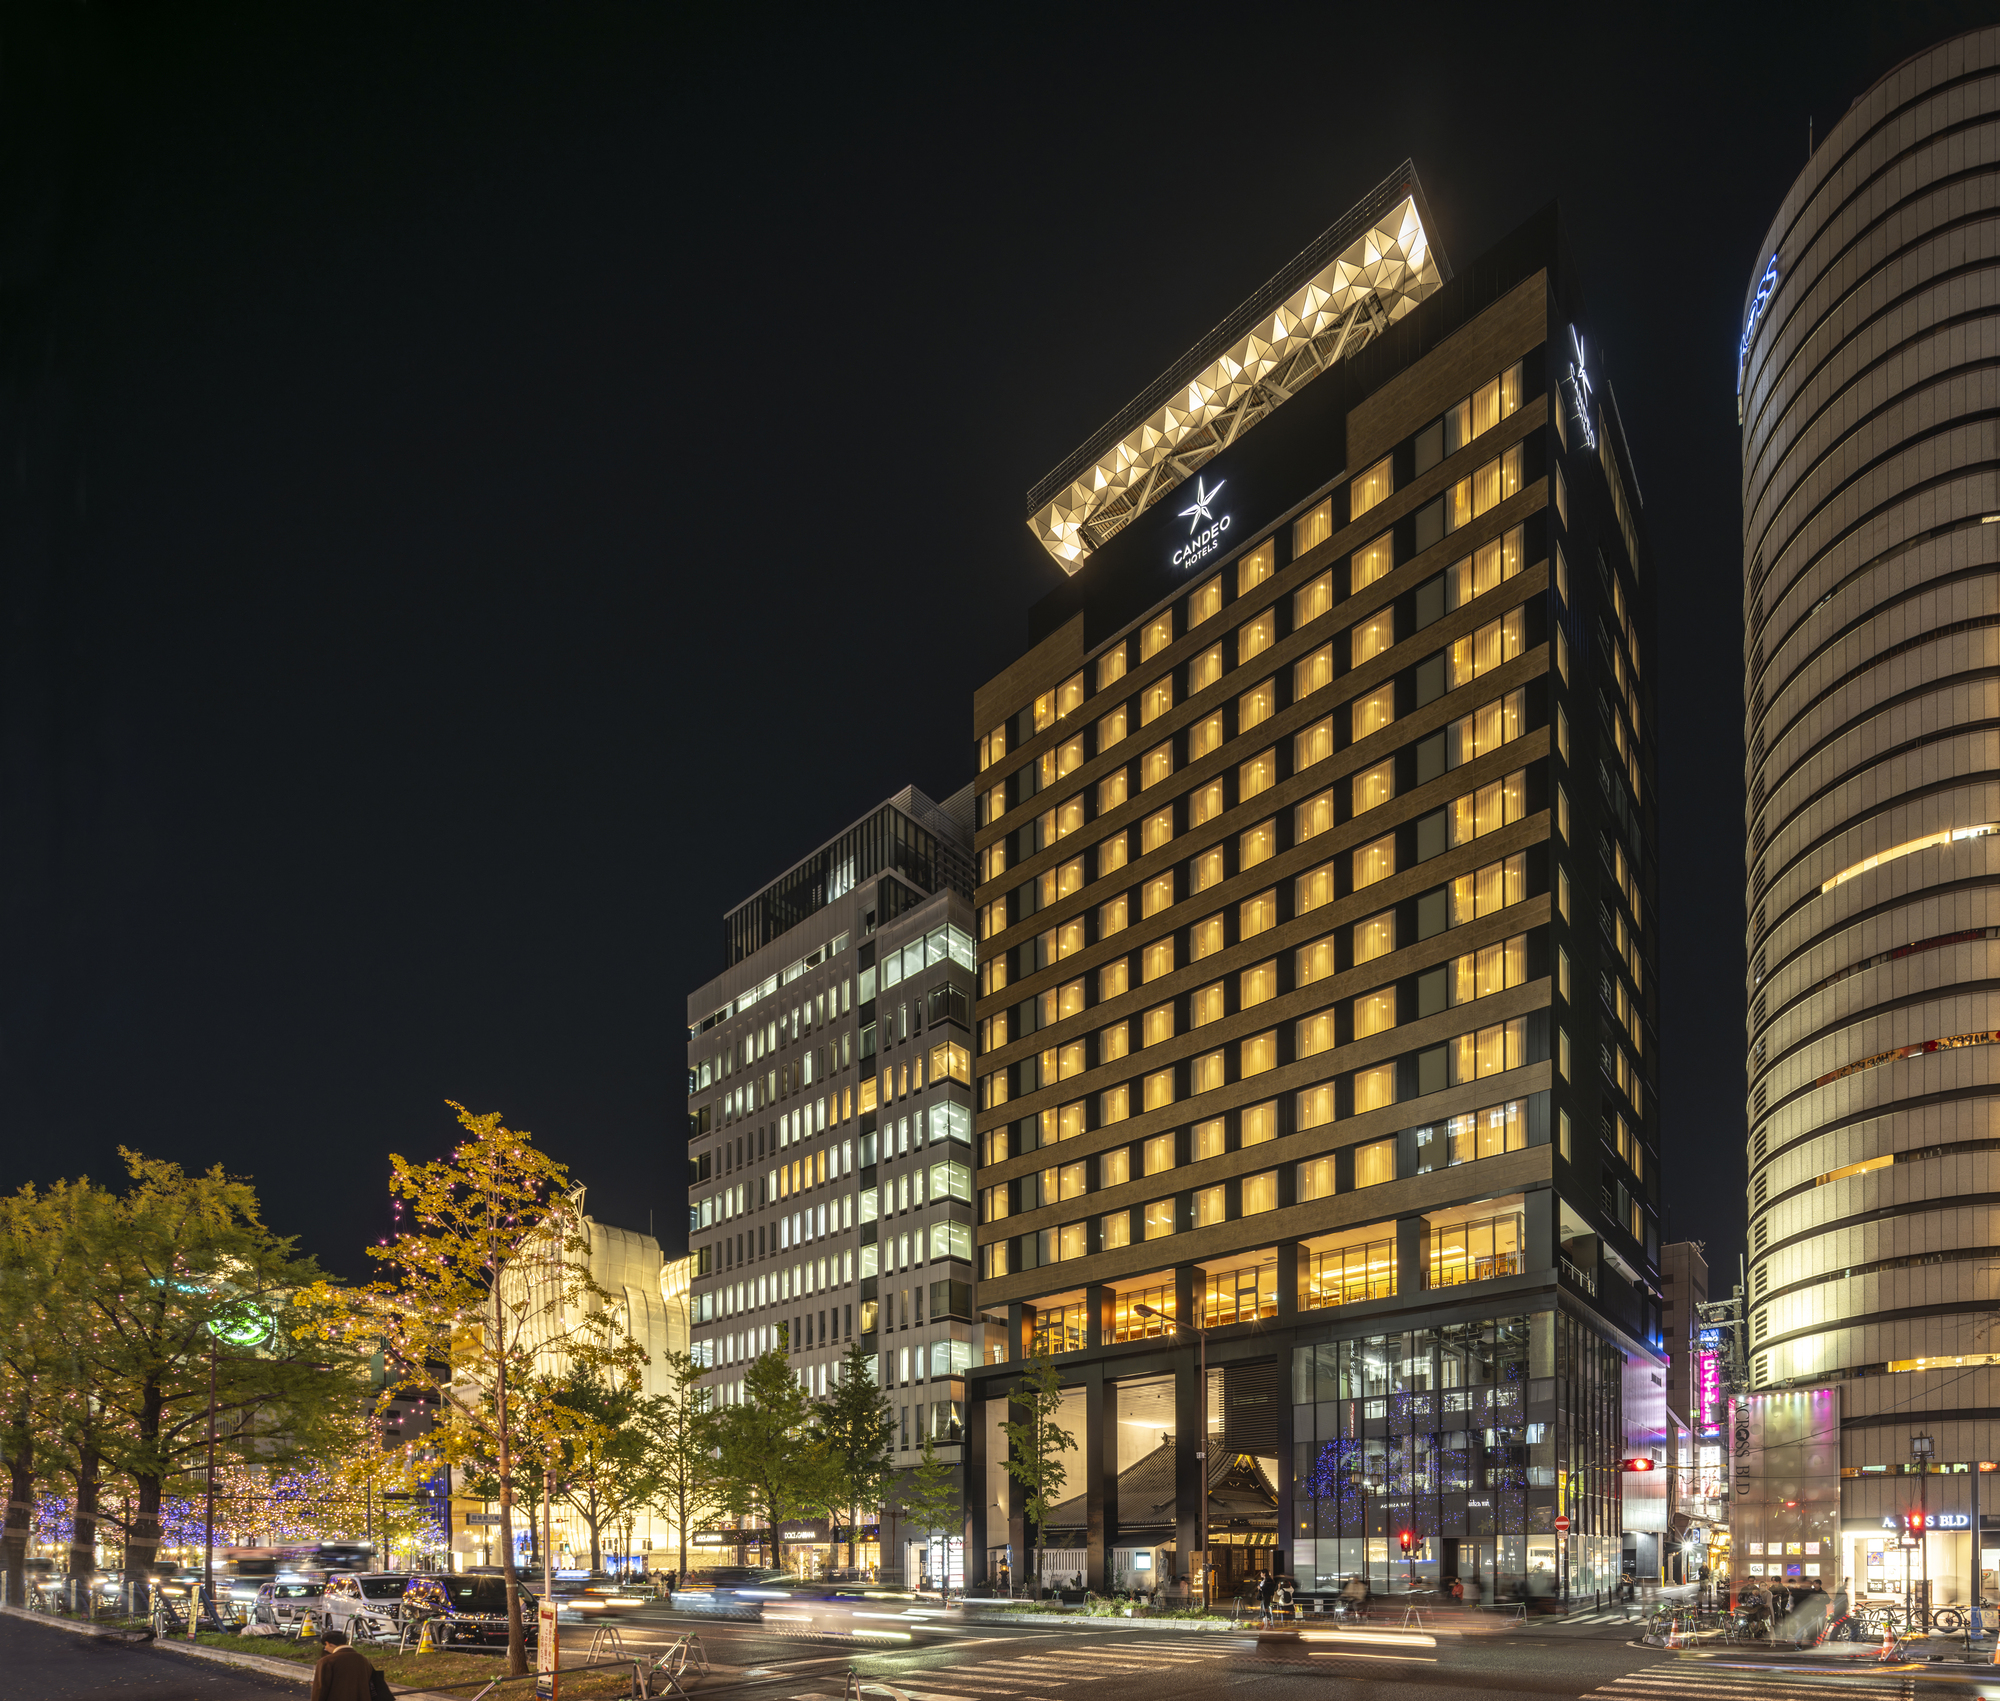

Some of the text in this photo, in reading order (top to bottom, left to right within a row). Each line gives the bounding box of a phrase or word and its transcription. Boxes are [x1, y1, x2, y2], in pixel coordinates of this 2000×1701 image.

[1173, 515, 1231, 565] CANDEO
[1185, 539, 1218, 569] HOTELS
[1735, 1400, 1750, 1496] ACROSS BLD
[1939, 1515, 1969, 1527] BLD
